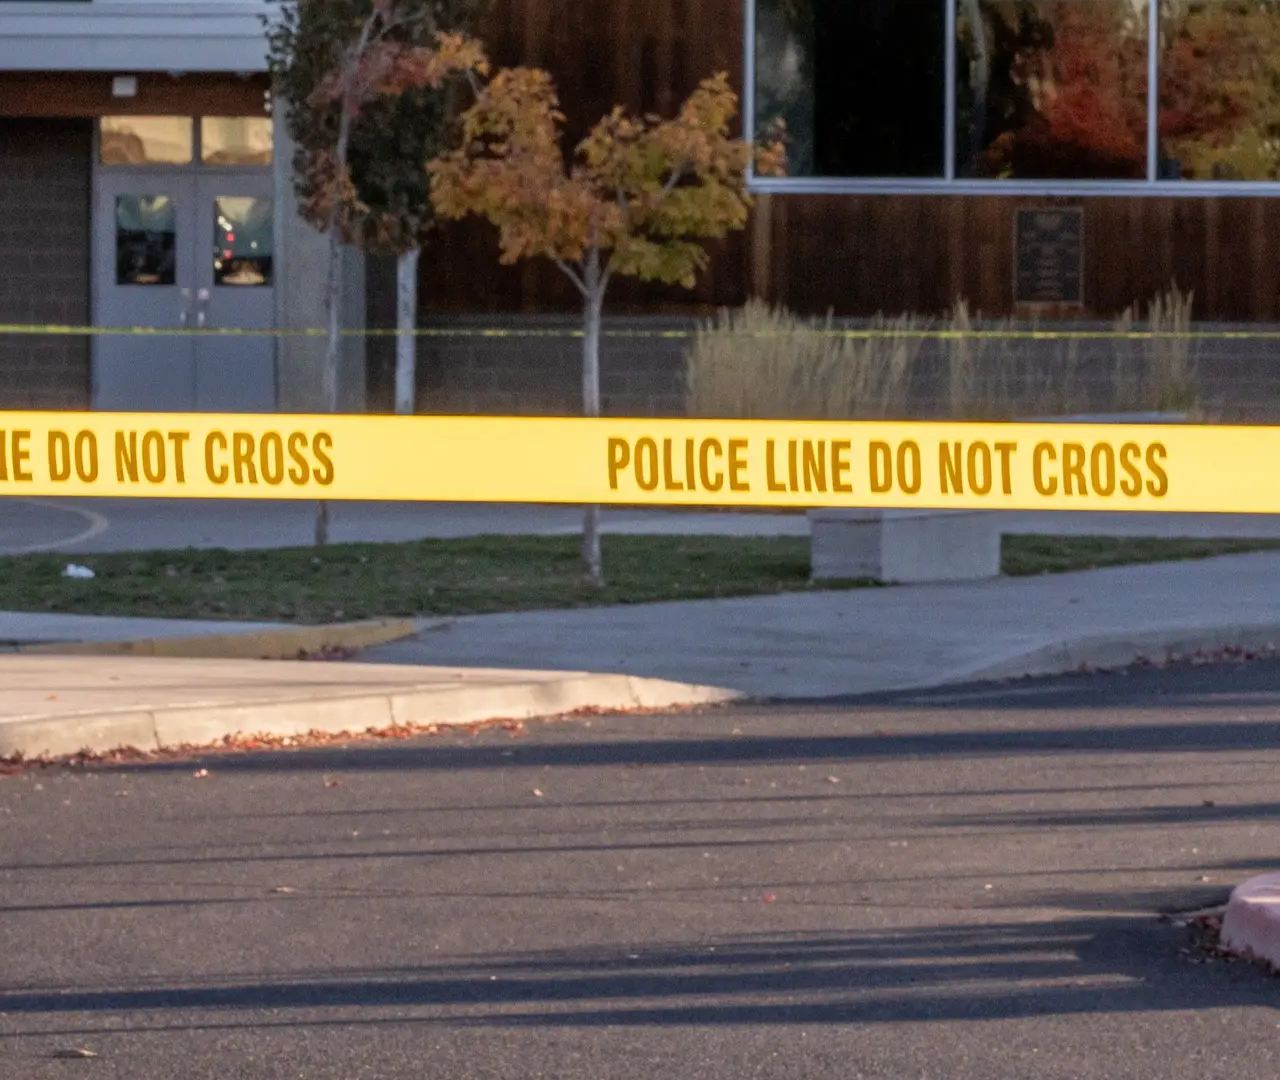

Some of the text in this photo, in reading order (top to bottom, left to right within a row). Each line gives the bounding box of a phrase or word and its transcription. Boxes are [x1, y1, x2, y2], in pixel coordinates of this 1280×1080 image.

[47, 429, 99, 483] DO
[115, 430, 190, 484] NOT
[204, 431, 335, 486] CROSS
[607, 437, 1169, 497] POLICE LINE DO NOT CROSS
